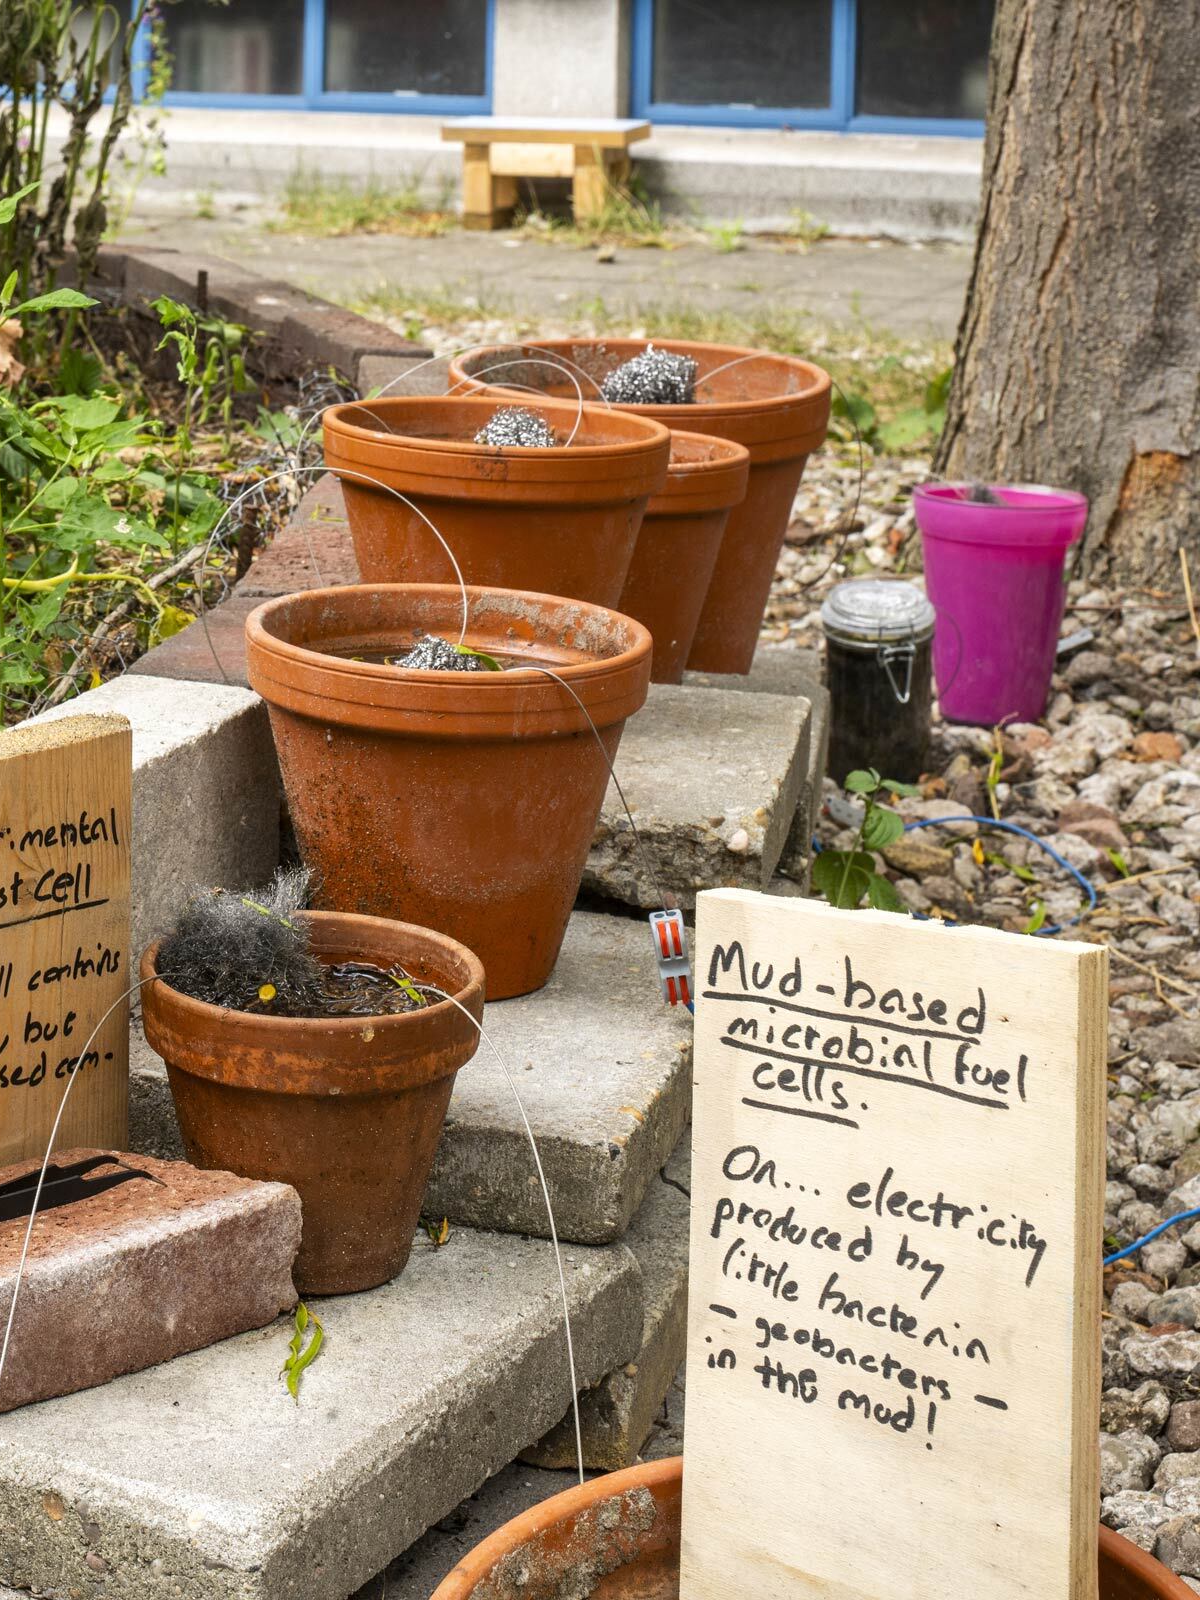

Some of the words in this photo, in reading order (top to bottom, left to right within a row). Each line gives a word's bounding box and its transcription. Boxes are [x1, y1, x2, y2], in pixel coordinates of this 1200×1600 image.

[27, 942, 121, 992] contains
[707, 940, 986, 1035] Mud-based
[23, 1011, 77, 1044] but
[726, 1008, 933, 1081] microbial
[954, 1042, 1029, 1101] fuel
[710, 1197, 873, 1262] produced
[896, 1234, 945, 1301] by
[846, 1167, 1048, 1287] electricity
[755, 1317, 952, 1401] geobacters
[818, 1272, 990, 1364] bacteria
[705, 1335, 738, 1369] in
[753, 1355, 819, 1404] the
[837, 1389, 938, 1451] mud!
